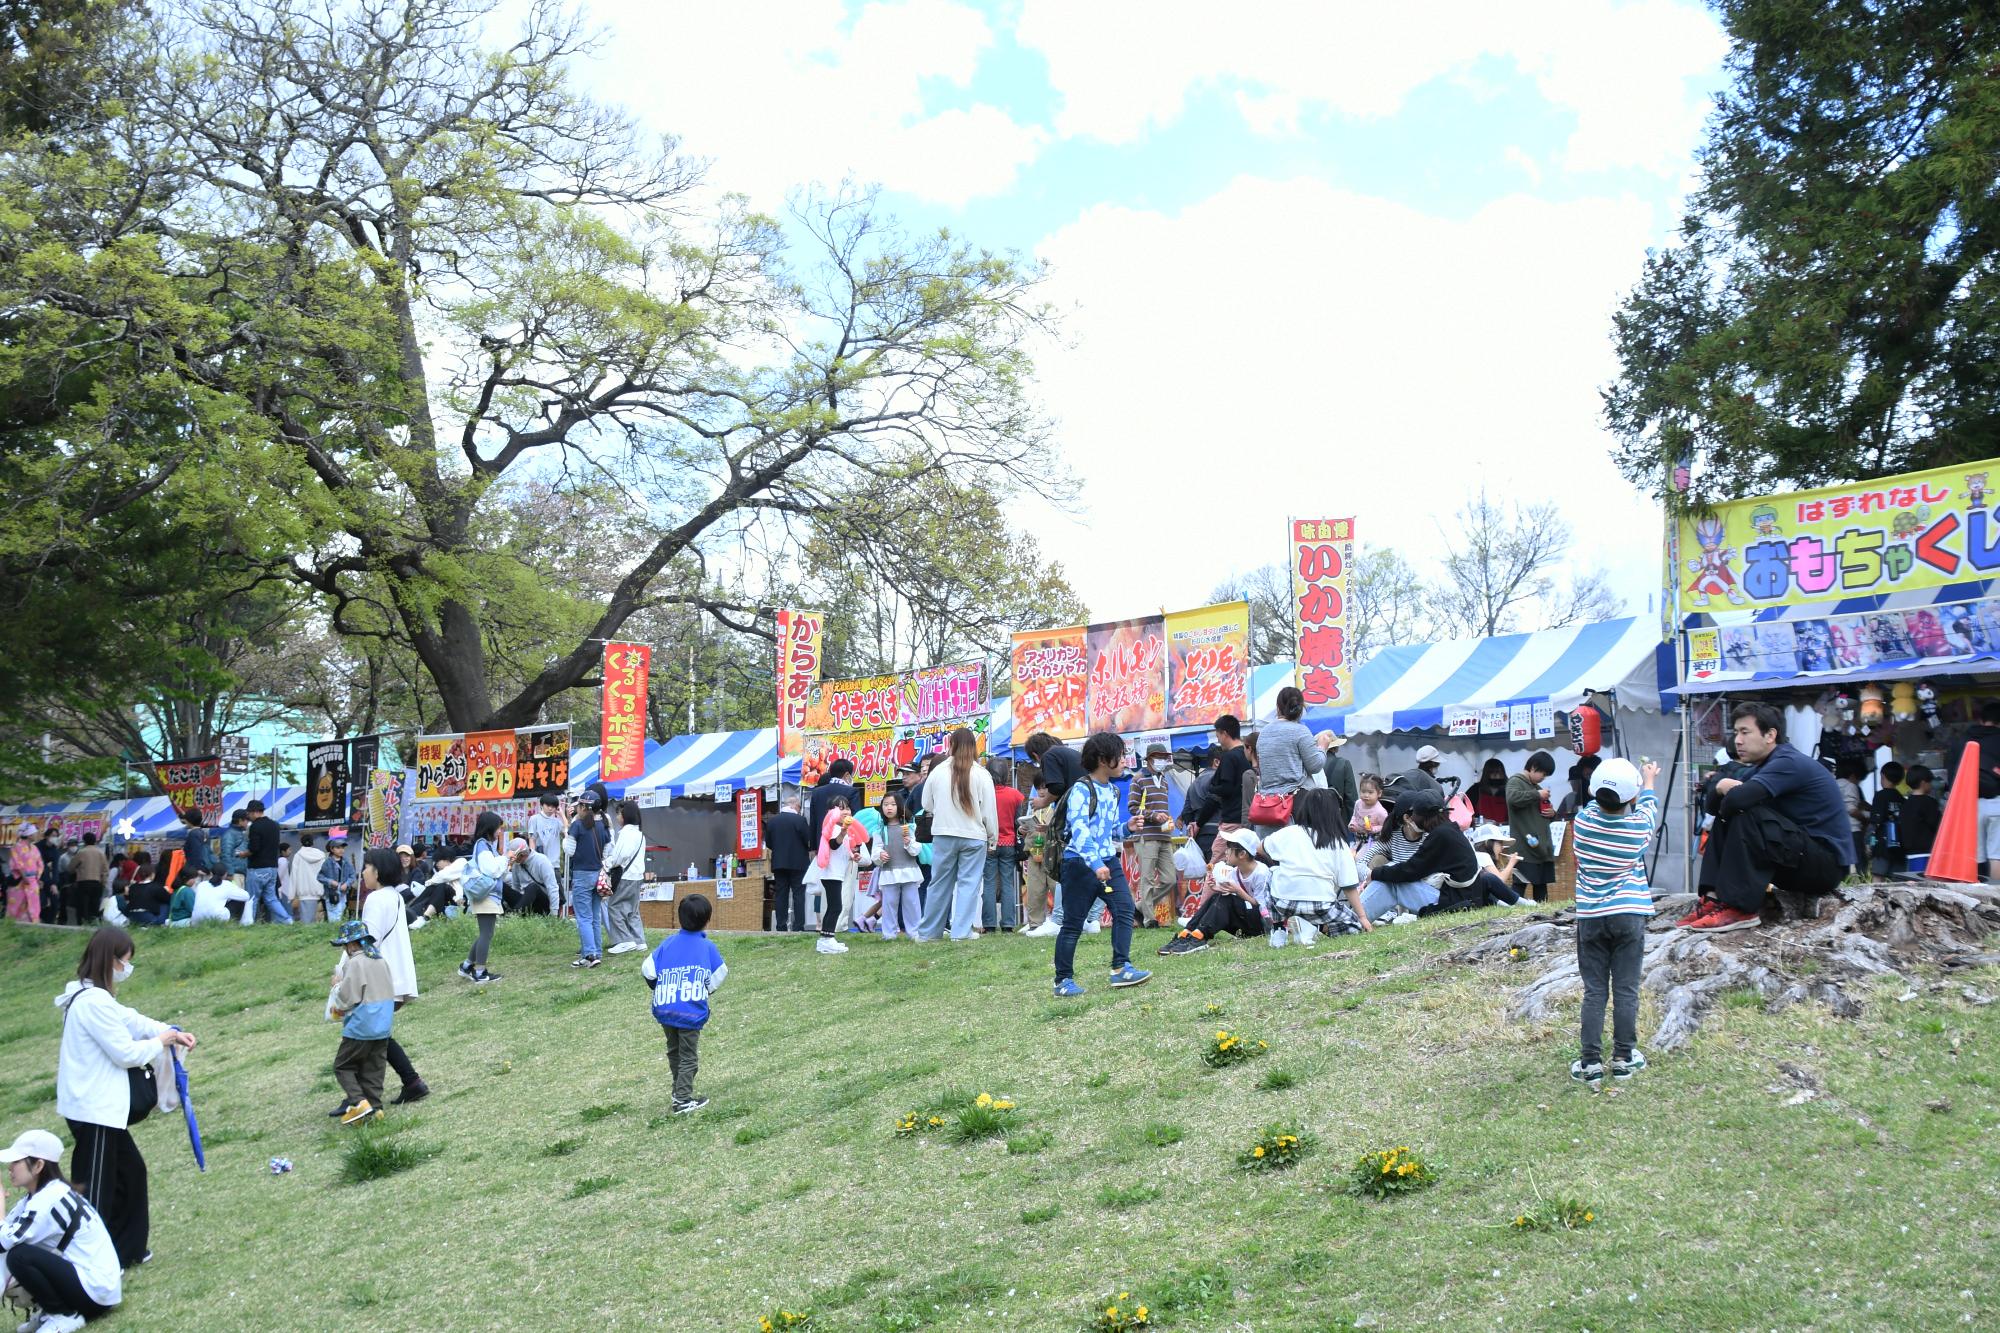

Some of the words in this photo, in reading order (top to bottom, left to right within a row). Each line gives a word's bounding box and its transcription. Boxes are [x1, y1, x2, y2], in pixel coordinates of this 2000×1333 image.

[1797, 484, 1949, 522] はずれなし
[1299, 544, 1344, 704] いか焼き
[787, 613, 820, 730] からあげ
[1017, 659, 1088, 681] シャカシャカ
[1024, 647, 1080, 665] アメリカン
[1091, 633, 1164, 686] ホルモン
[1692, 659, 1717, 671] 受付
[831, 685, 898, 729] やきそば
[1023, 680, 1080, 708] ポテト
[604, 652, 636, 777] くるくるポテト
[312, 752, 345, 769] POTATO
[419, 743, 442, 761] 特製
[827, 737, 893, 780] からあげ
[467, 770, 511, 792] ポテト
[516, 759, 568, 790] 焼そば
